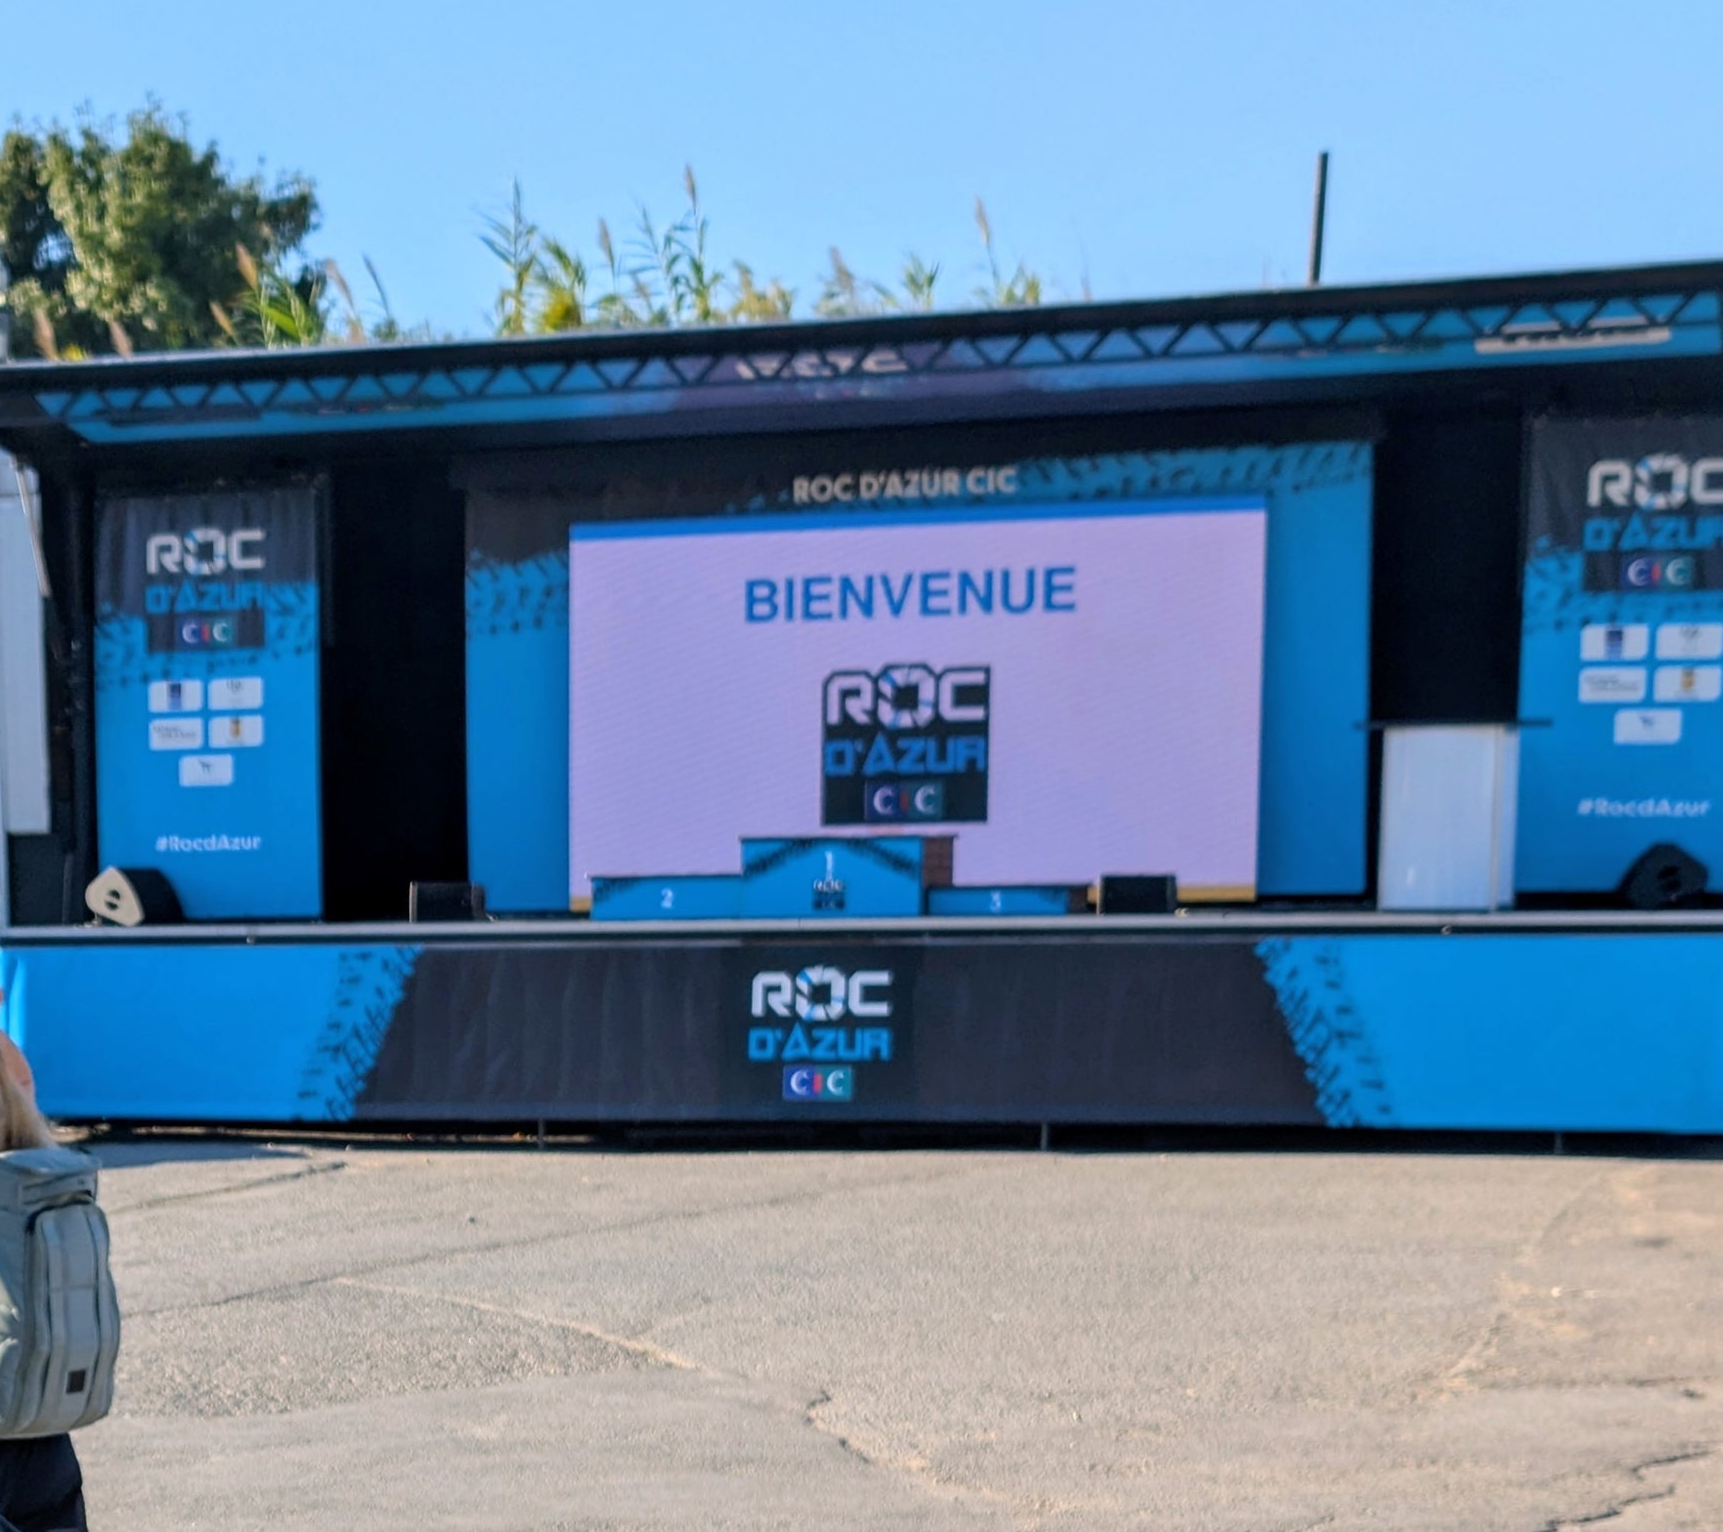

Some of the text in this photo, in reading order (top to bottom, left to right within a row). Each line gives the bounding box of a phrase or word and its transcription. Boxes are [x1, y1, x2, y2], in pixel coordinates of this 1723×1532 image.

[792, 465, 1017, 504] ROC D'AZUR CIC
[1587, 453, 1723, 510] ROC
[145, 527, 266, 575] ROC
[1627, 557, 1691, 587] CIC
[144, 580, 264, 614] D'AZUR
[744, 564, 1076, 623] BIENVENUE
[182, 622, 229, 645] CIC
[826, 667, 987, 730] ROC
[825, 732, 987, 777] D'AZUR
[873, 784, 936, 816] CIC
[155, 834, 263, 853] #RocdAzur
[660, 887, 674, 909] 2
[751, 965, 893, 1021] ROC
[747, 1021, 893, 1062] D'AZUR
[789, 1069, 845, 1097] CIC
